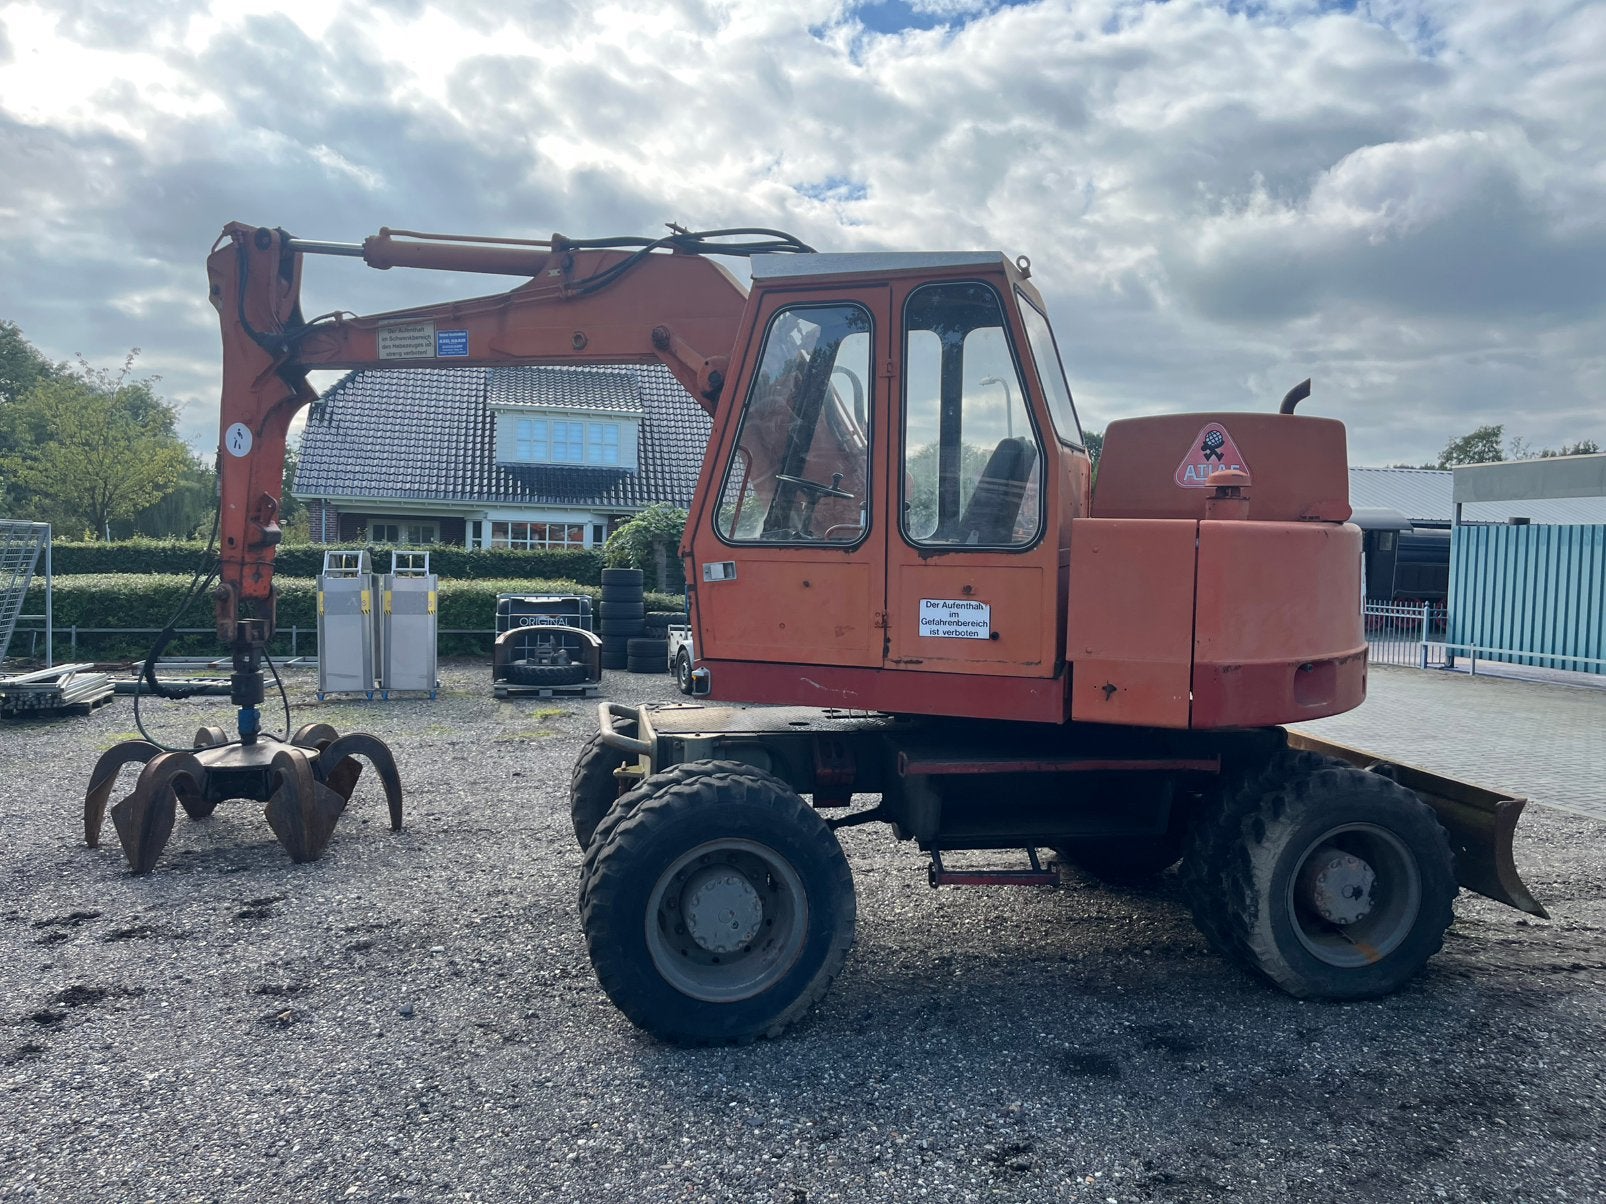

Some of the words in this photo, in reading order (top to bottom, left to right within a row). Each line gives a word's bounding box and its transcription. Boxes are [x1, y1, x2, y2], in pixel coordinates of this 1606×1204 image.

[942, 602, 984, 610] Aufenthalt
[520, 617, 570, 627] ORIGINAL
[921, 618, 988, 627] Gefahrenbereich
